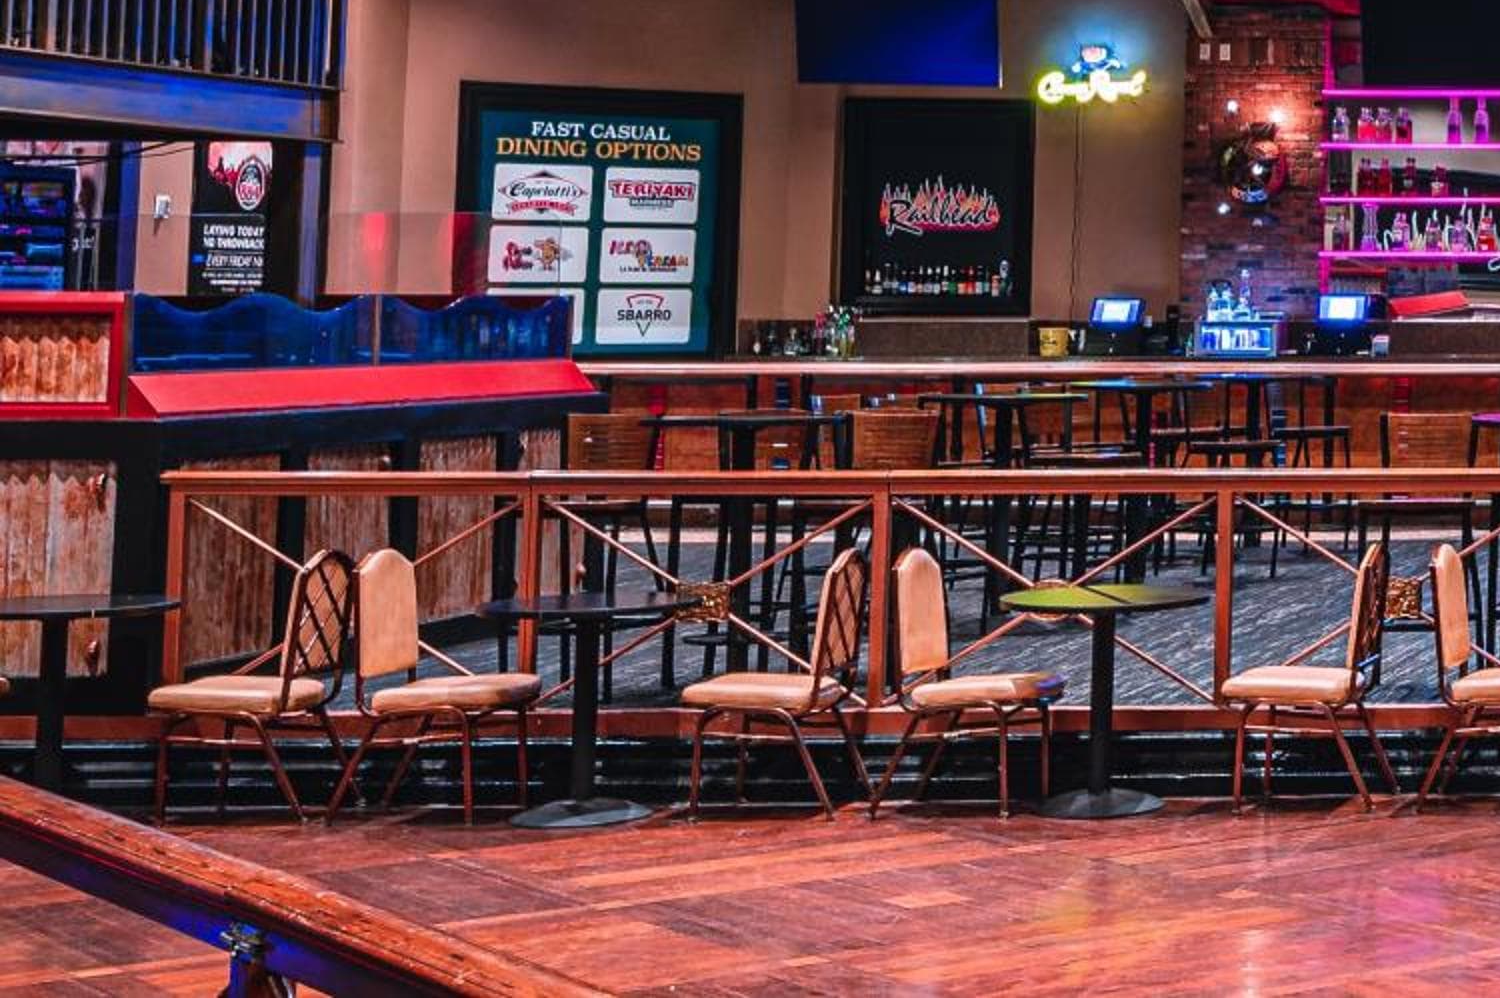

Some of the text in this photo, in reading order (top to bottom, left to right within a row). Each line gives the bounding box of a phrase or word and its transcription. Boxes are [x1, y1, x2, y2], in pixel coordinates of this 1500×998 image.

[531, 121, 670, 141] FAST CASUAL
[496, 137, 701, 162] DINING OPTIONS
[509, 182, 578, 199] Capriotti's
[613, 183, 693, 200] TERIYAKI
[886, 199, 990, 236] Railhead
[617, 309, 671, 321] SBARRO
